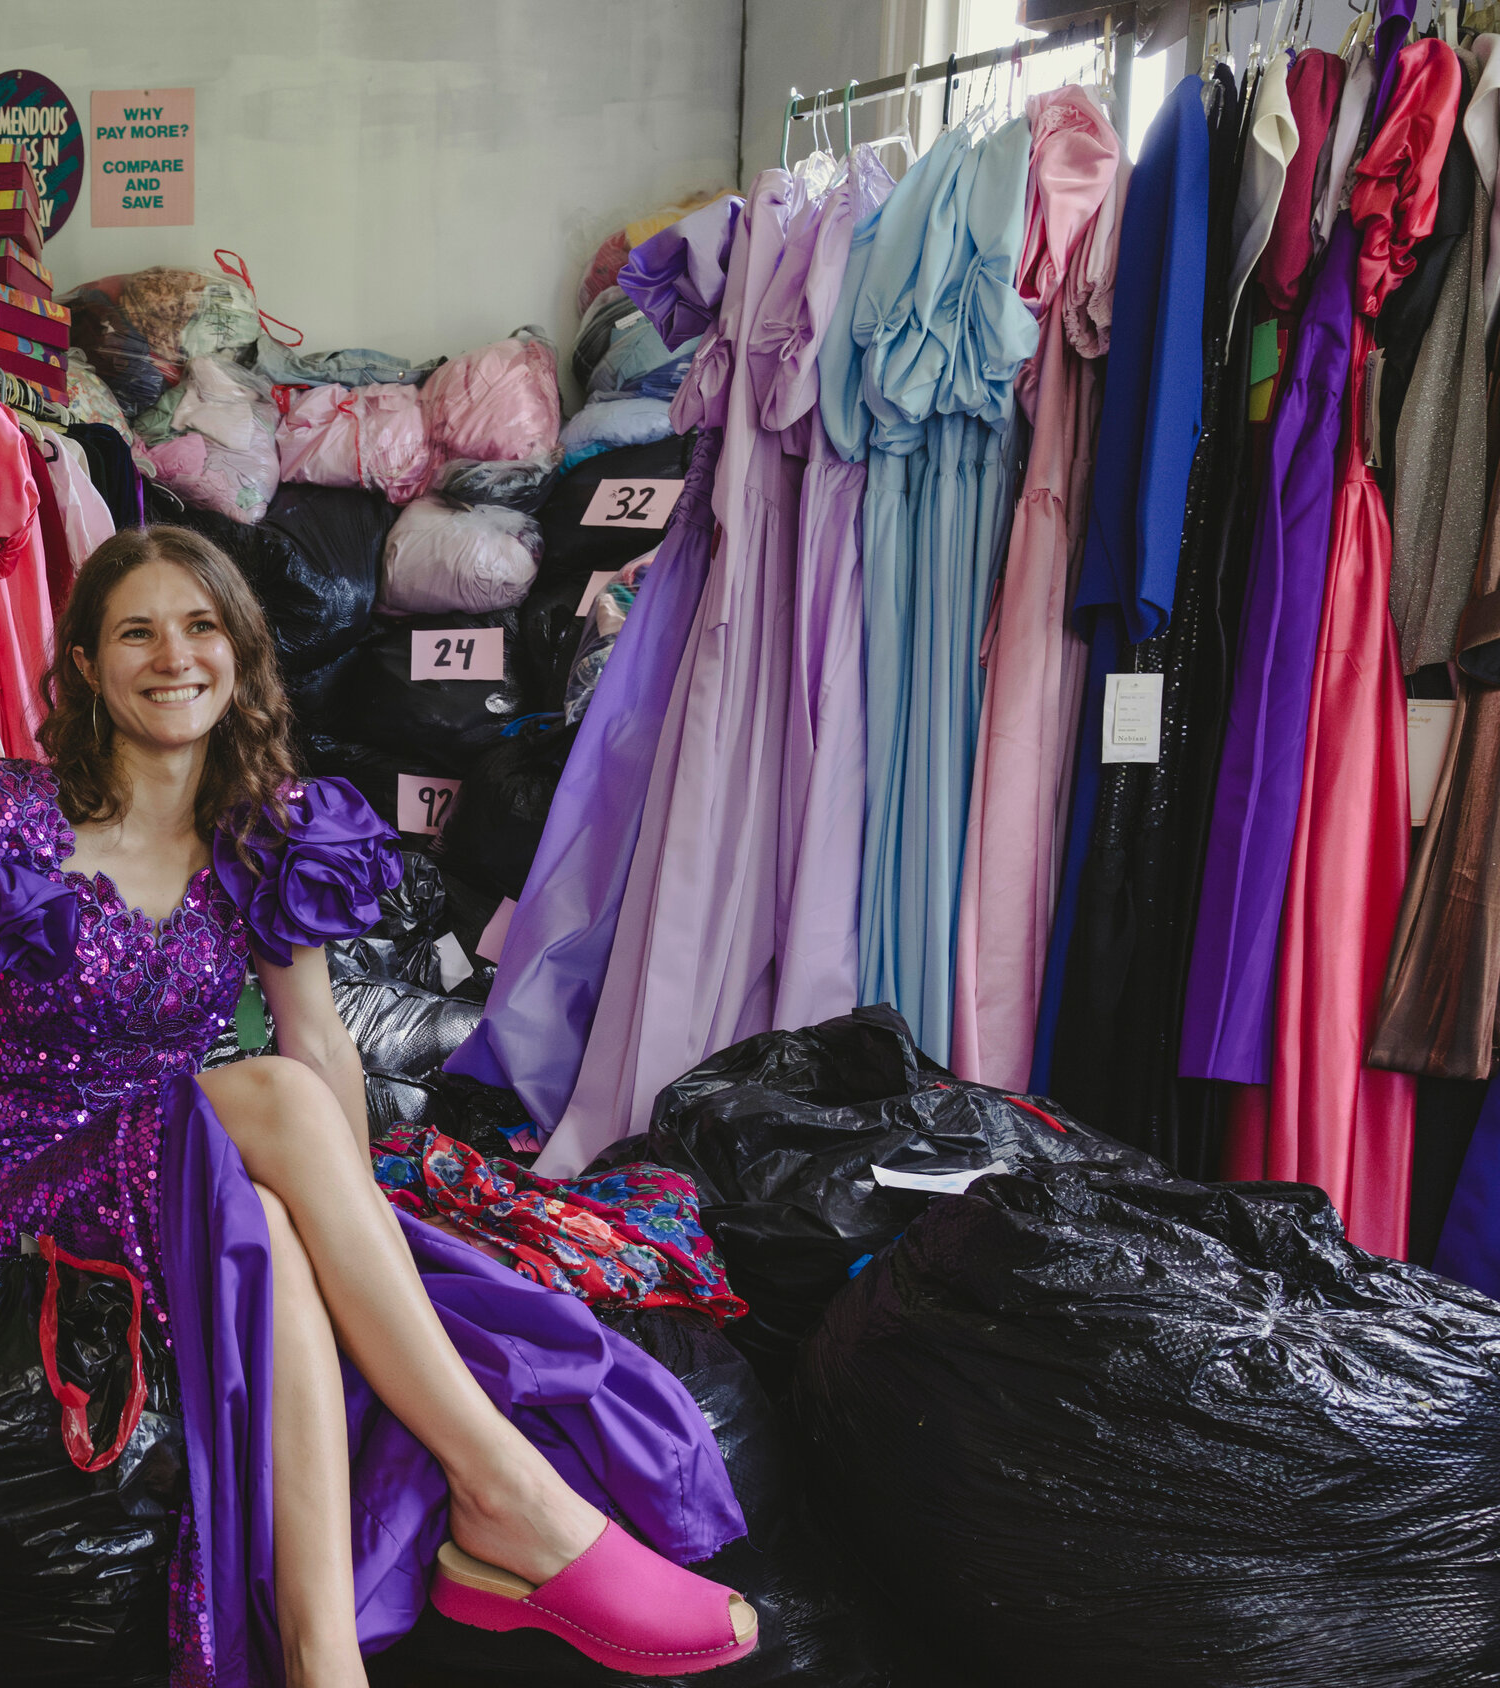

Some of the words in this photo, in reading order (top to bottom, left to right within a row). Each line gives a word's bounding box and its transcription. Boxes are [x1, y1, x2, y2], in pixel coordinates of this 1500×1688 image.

[123, 107, 164, 121] WHY
[96, 126, 127, 140] PAY
[130, 124, 189, 139] MORE?
[42, 138, 59, 166] IN
[102, 159, 184, 174] COMPARE
[125, 178, 161, 191] AND
[121, 195, 164, 209] SAVE
[605, 486, 656, 520] 32
[433, 638, 475, 670] 24
